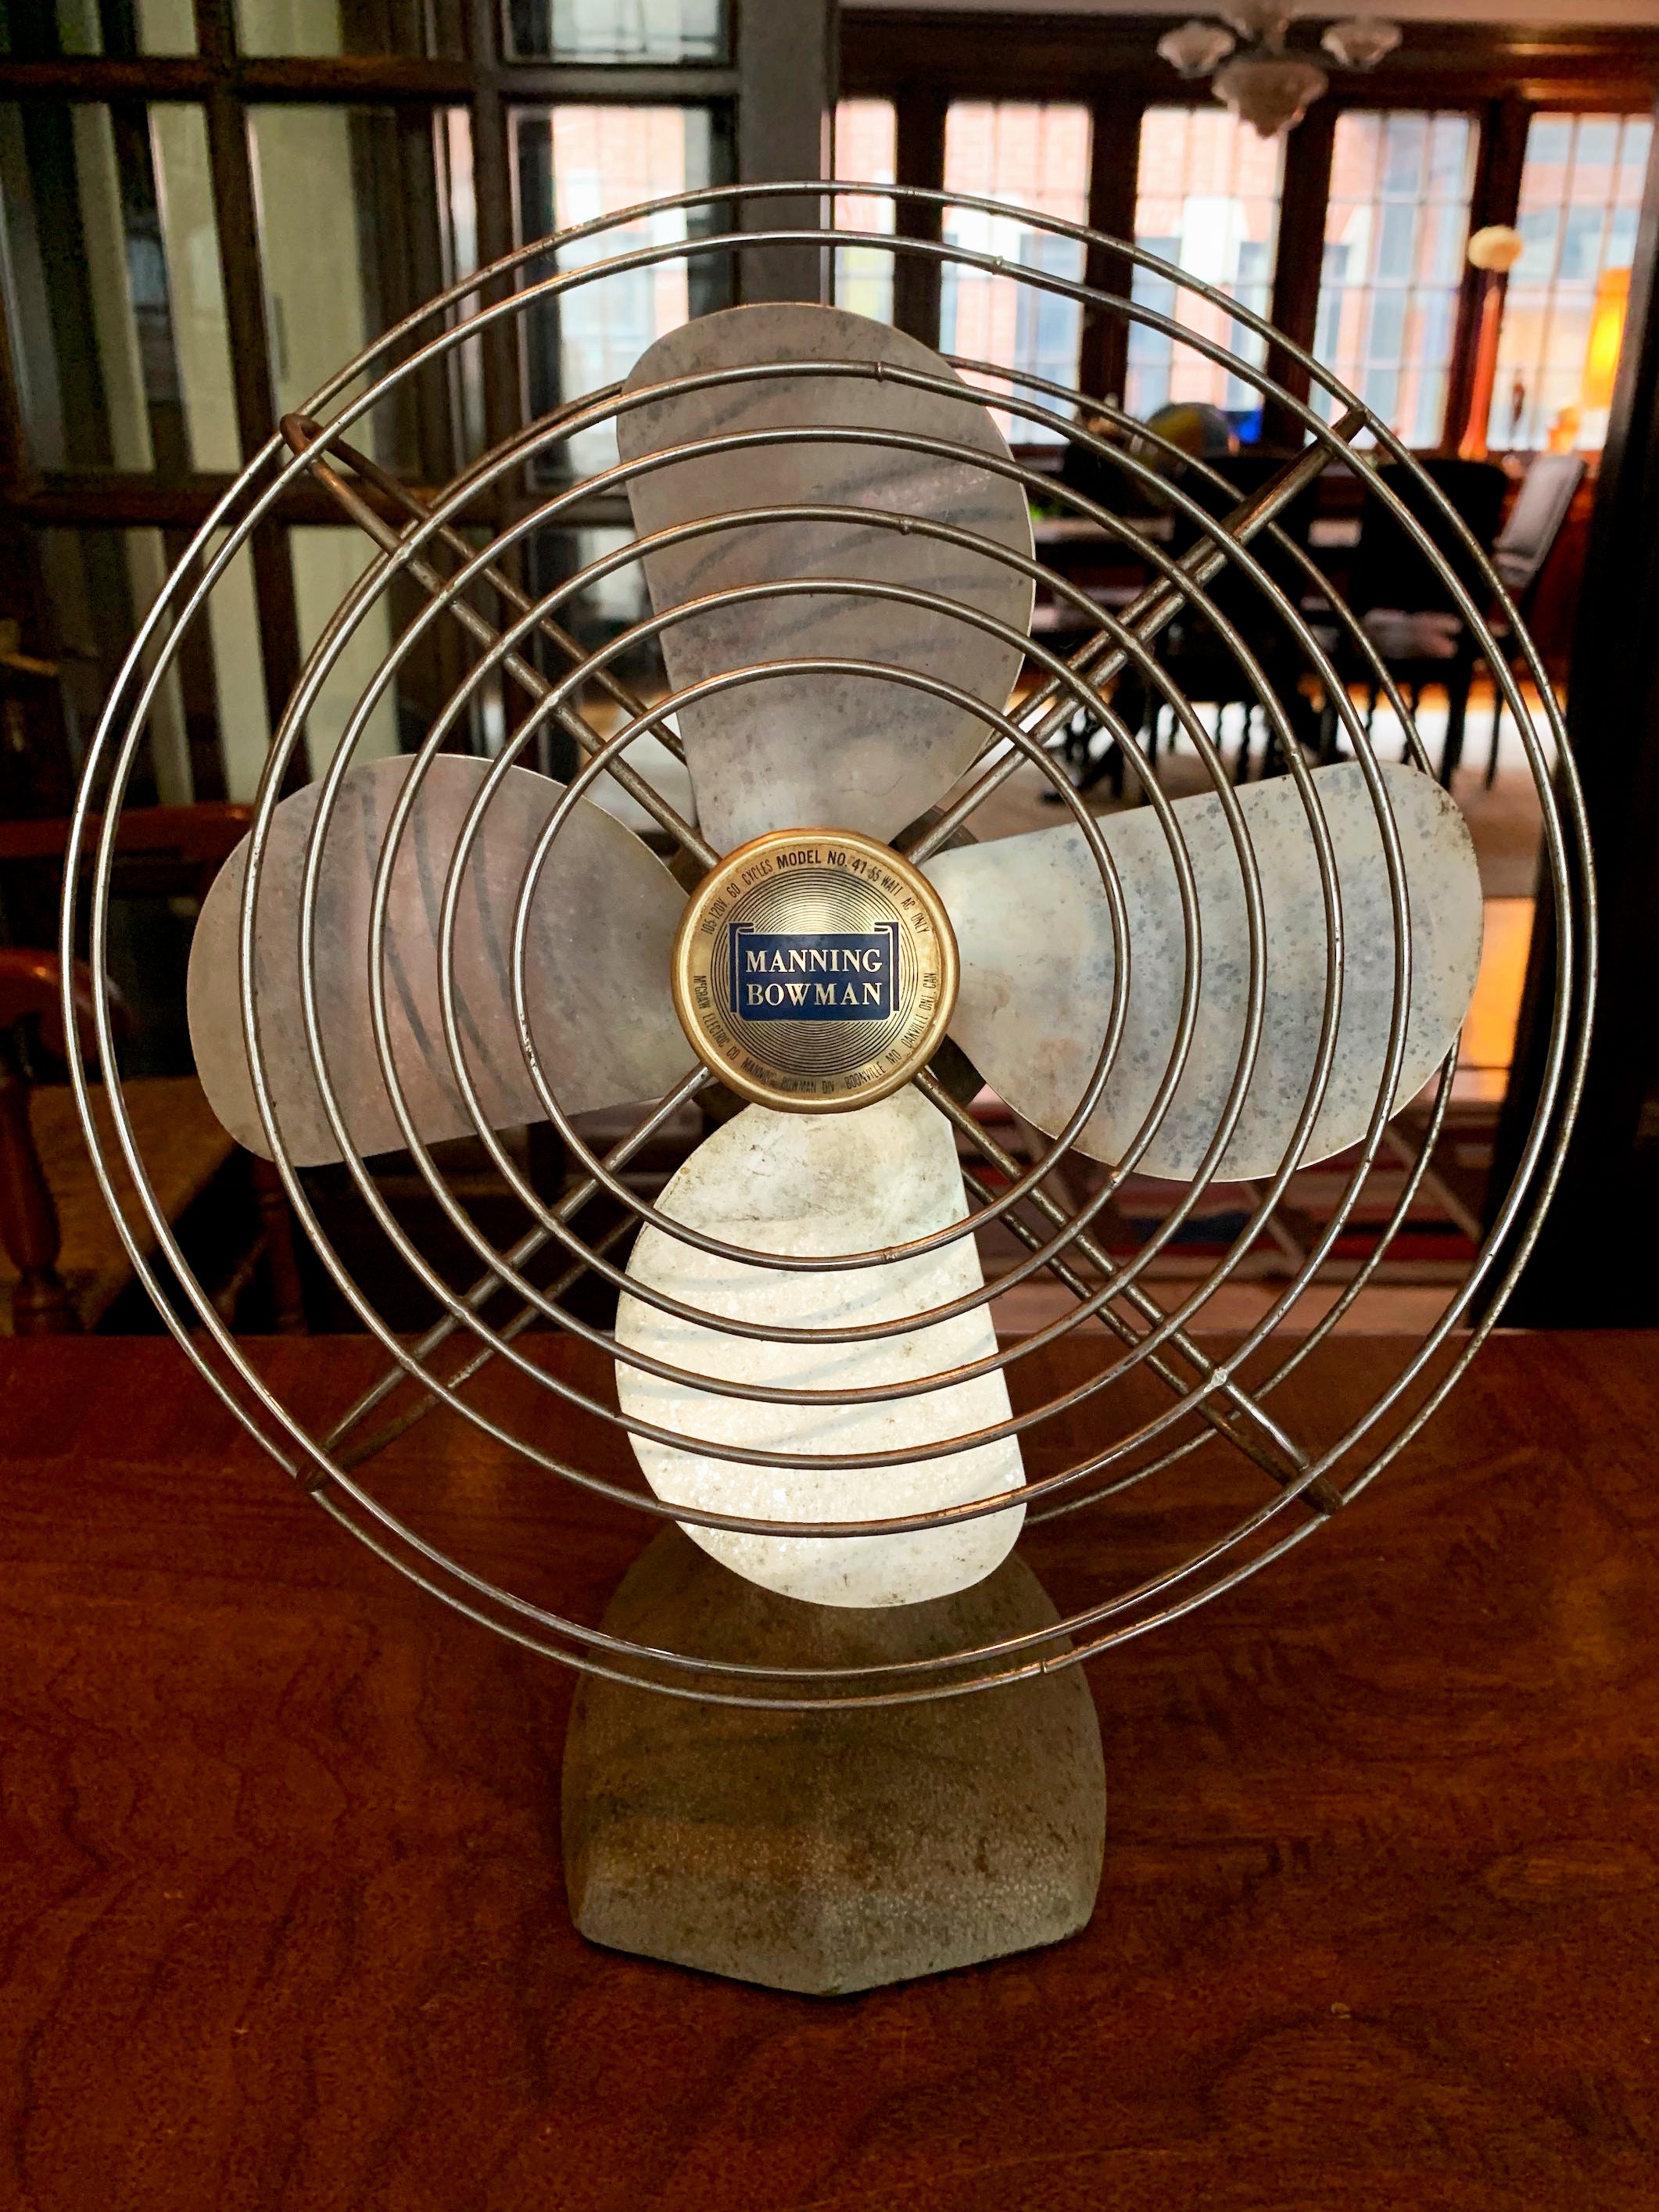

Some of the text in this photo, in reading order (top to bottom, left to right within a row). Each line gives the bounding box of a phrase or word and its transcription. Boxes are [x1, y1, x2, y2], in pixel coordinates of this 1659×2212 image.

[726, 883, 741, 898] 60
[741, 859, 773, 885] CYCLES
[776, 850, 822, 869] MODEL
[827, 851, 847, 867] NO.
[851, 859, 868, 874] 41
[868, 866, 882, 882] 55
[880, 876, 904, 897] WATT
[901, 897, 915, 911] AC
[910, 912, 930, 934] ONLY
[745, 948, 883, 973] MANNING
[746, 982, 883, 1006] BOWMAN
[703, 1013, 730, 1048] ELECTRIC
[726, 1046, 740, 1060] CO
[844, 1061, 886, 1089] BOONVILLE
[885, 1049, 901, 1065] MO
[901, 1013, 928, 1049] OAKVILLE
